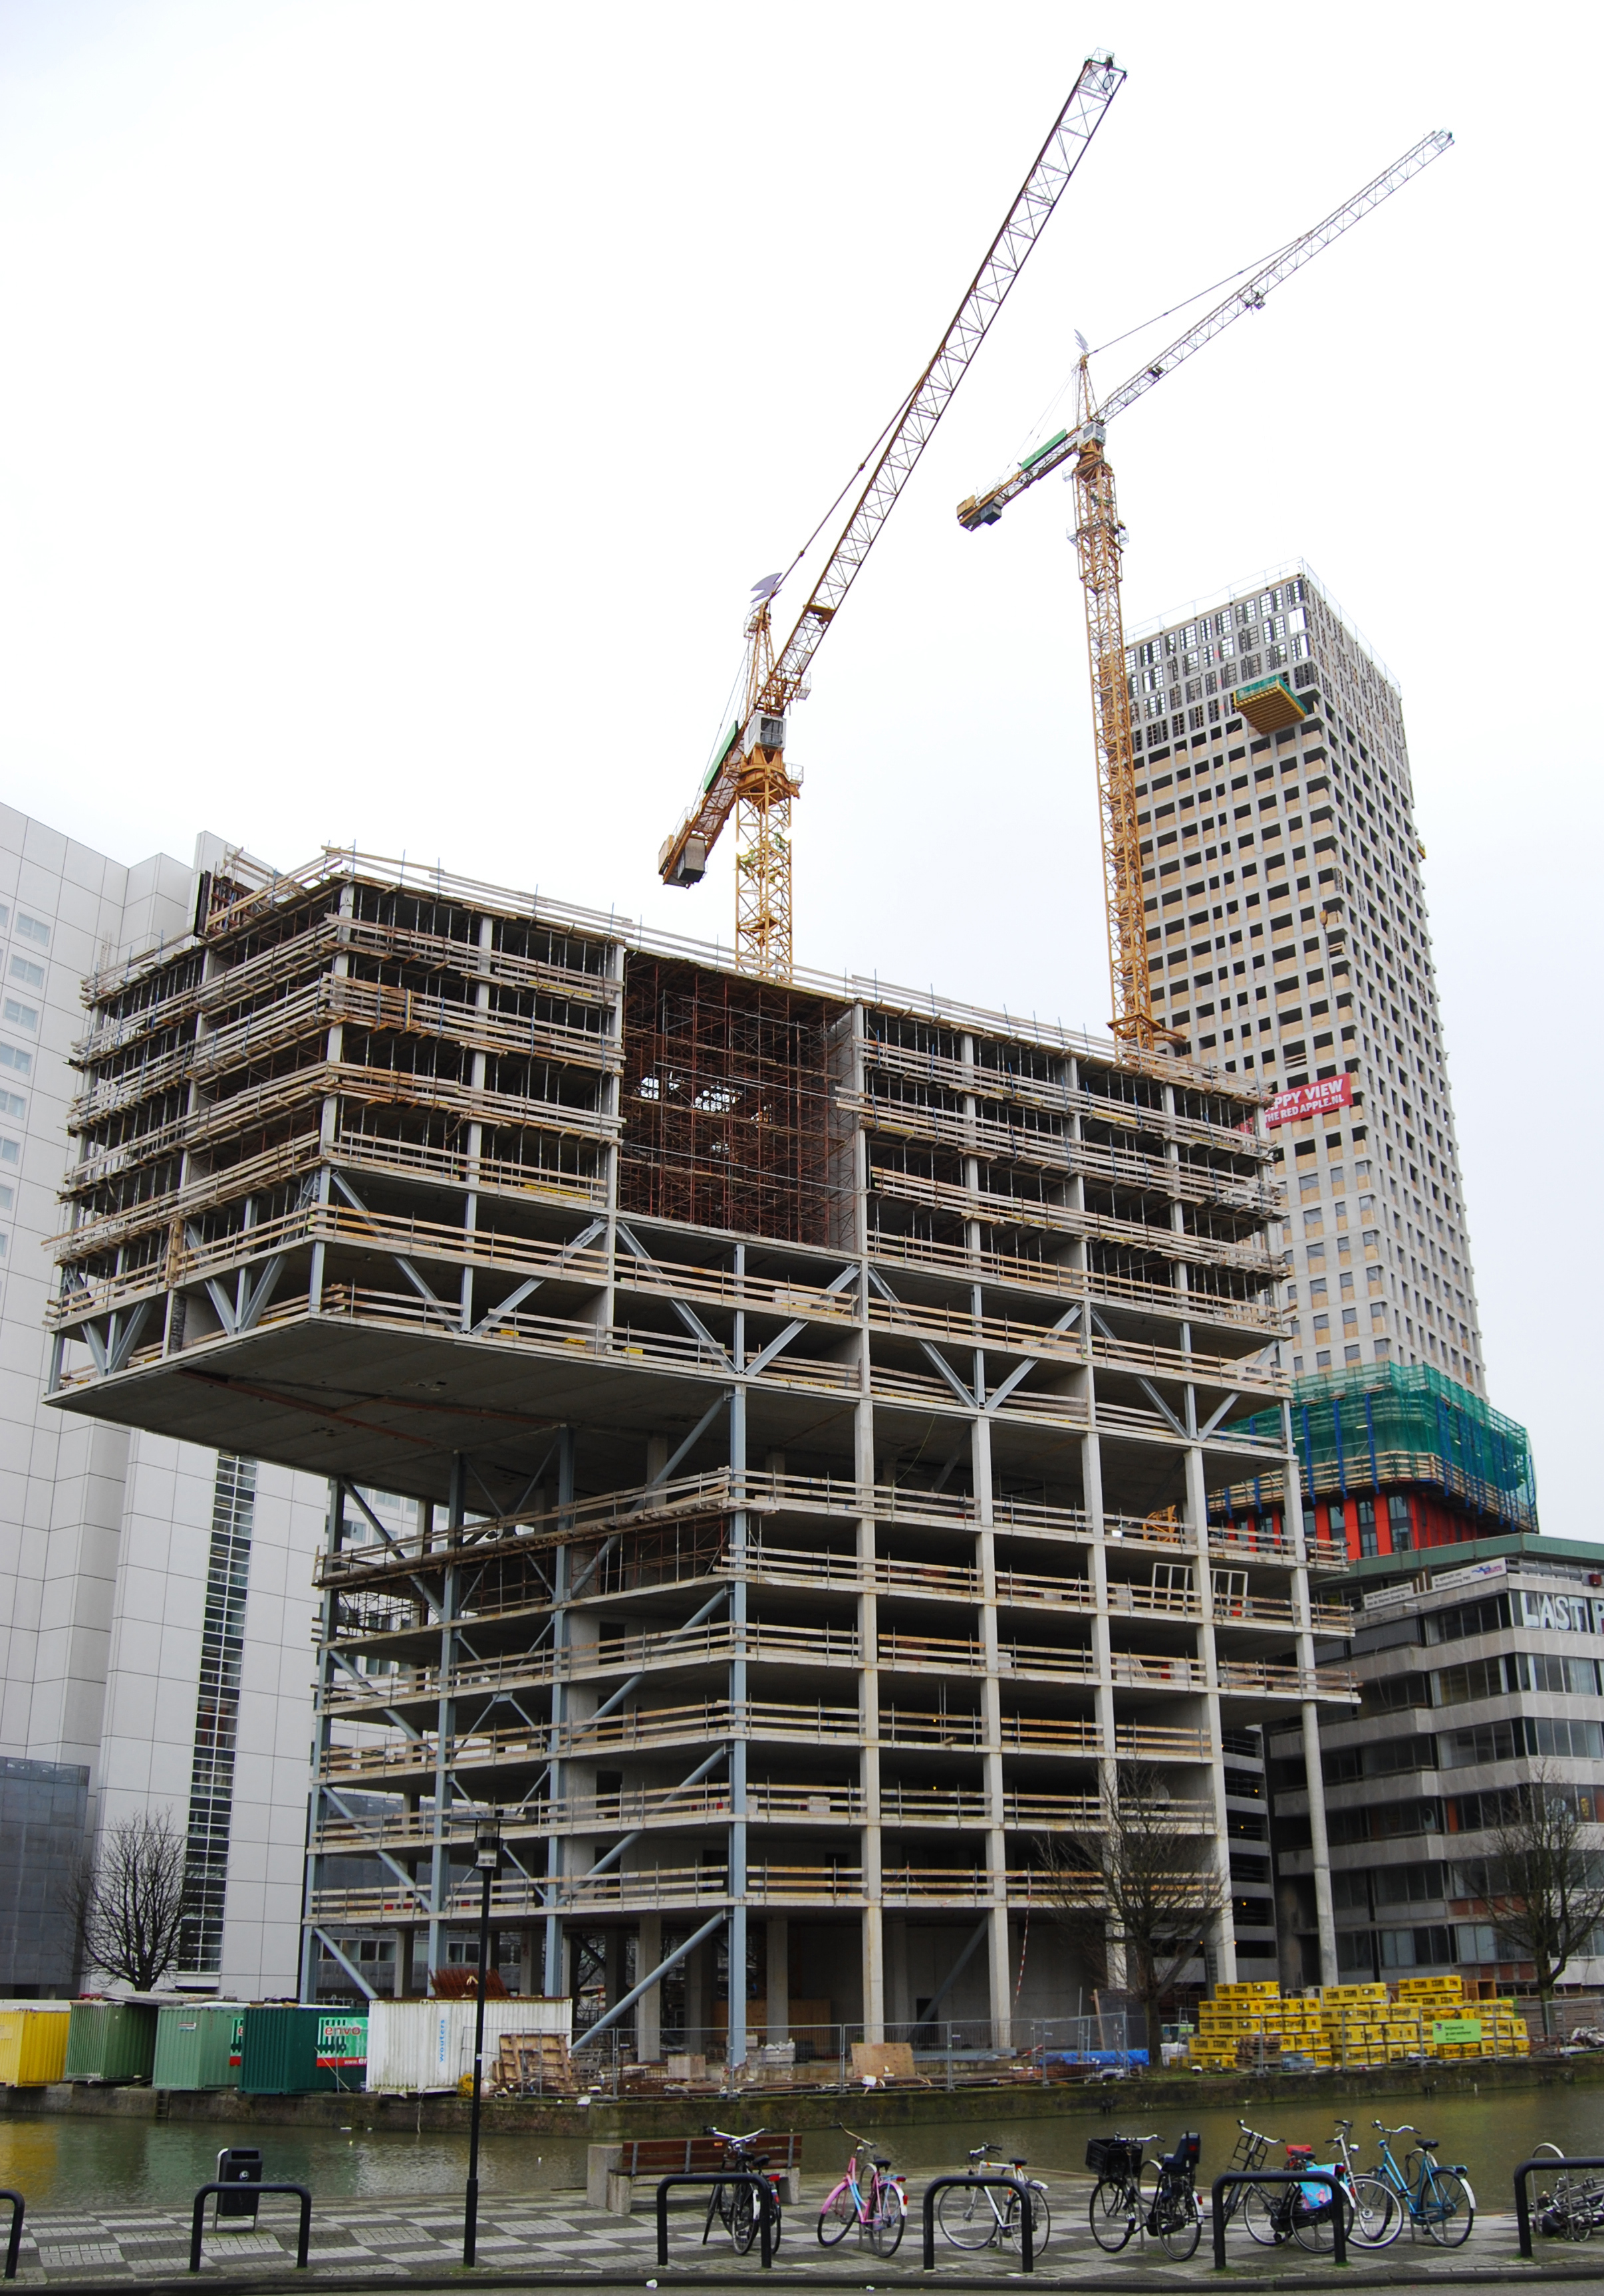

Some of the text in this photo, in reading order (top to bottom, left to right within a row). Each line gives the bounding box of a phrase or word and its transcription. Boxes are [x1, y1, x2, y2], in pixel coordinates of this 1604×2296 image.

[1304, 1079, 1343, 1100] VIEW
[1265, 1094, 1345, 1123] THE RED APPLE.NL
[1520, 1591, 1584, 1632] LAST
[325, 2026, 361, 2035] envo
